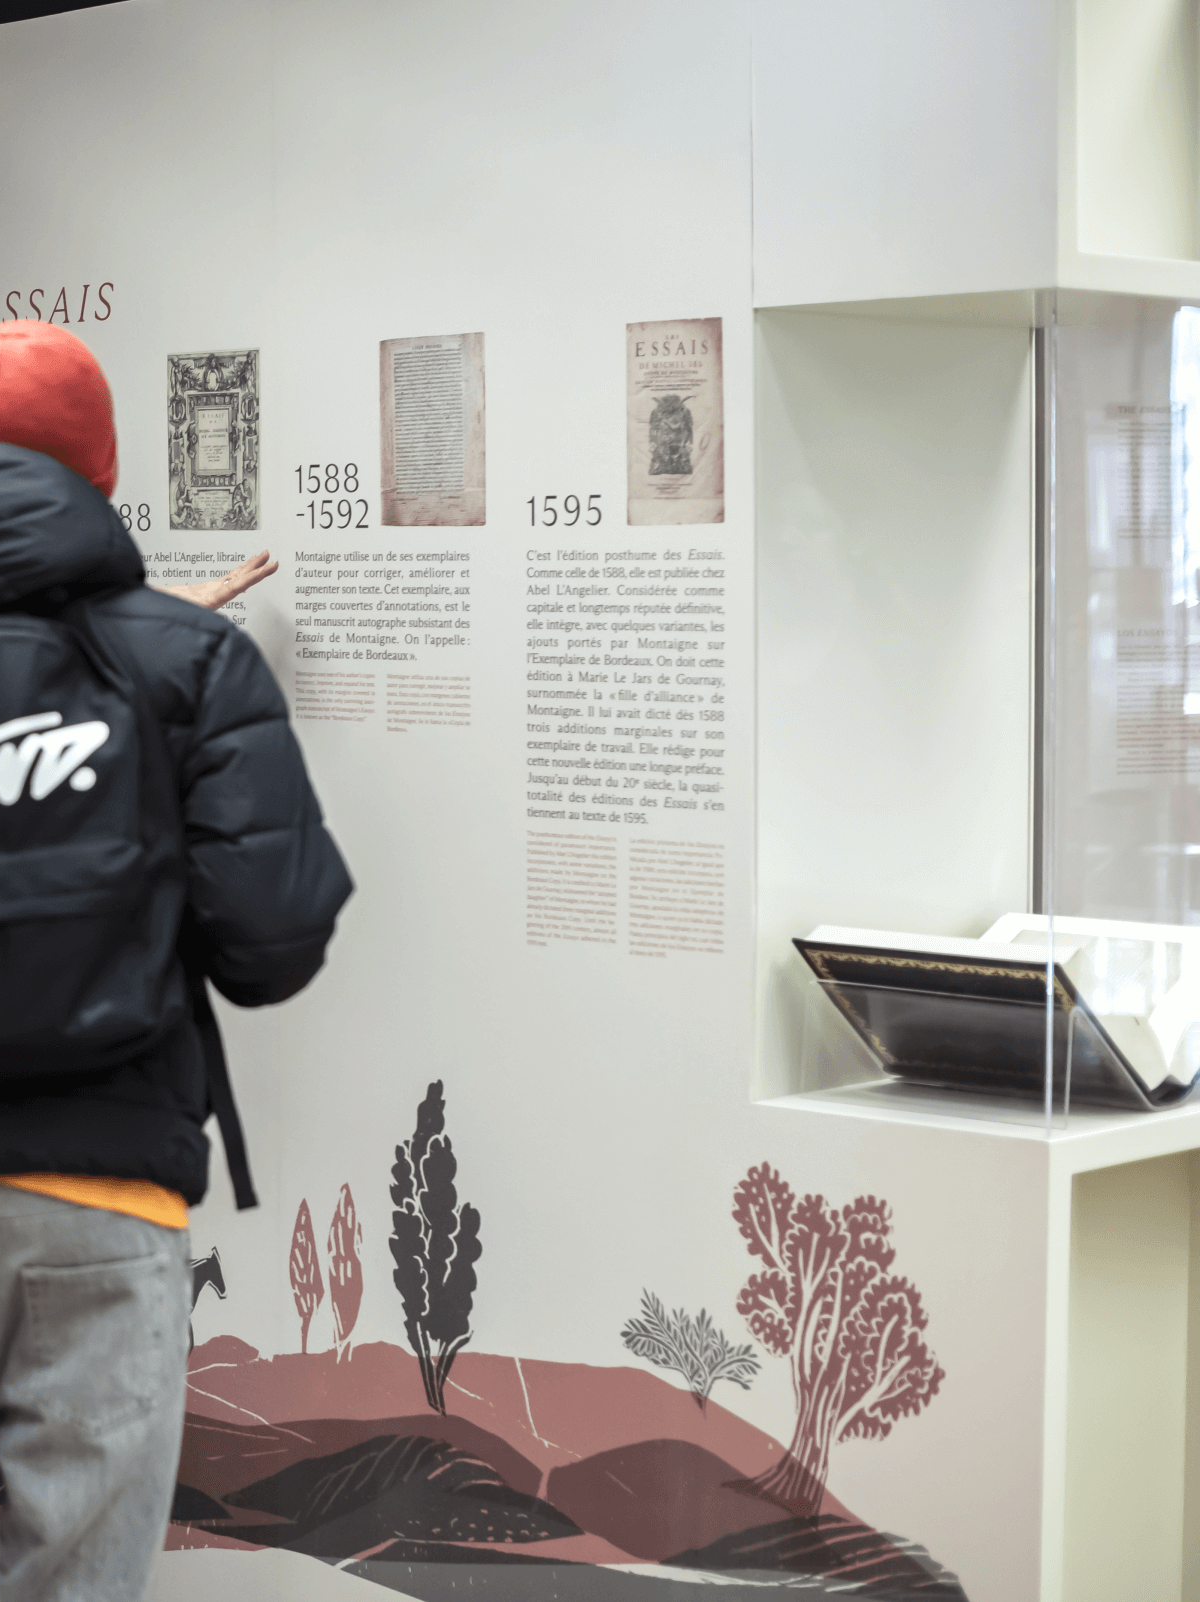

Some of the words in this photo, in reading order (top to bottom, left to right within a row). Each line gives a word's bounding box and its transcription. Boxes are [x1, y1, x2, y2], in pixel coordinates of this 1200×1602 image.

[636, 340, 708, 357] ESSAIS
[295, 463, 359, 493] 1588
[296, 499, 369, 529] -1592
[527, 494, 602, 526] 1595
[154, 552, 172, 562] Abel
[174, 552, 215, 564] L'Angelier,
[217, 552, 245, 562] libraire
[296, 552, 341, 564] Montaigne
[344, 552, 369, 561] utilise
[372, 553, 383, 561] un
[386, 552, 397, 561] de
[400, 553, 413, 561] ses
[416, 551, 469, 564] exemplaires
[526, 550, 551, 561] C'est
[557, 551, 598, 560] l'édition
[605, 551, 657, 562] posthume
[664, 550, 681, 560] des
[688, 549, 725, 560] Essais.
[162, 569, 191, 578] obtient
[295, 568, 332, 578] d'auteur
[337, 570, 359, 580] pour
[364, 570, 404, 580] corriger,
[409, 568, 455, 578] améliorer
[460, 570, 469, 578] et
[526, 568, 562, 577] Comme
[565, 568, 586, 577] celle
[589, 568, 600, 577] de
[603, 568, 627, 579] 1588,
[629, 568, 645, 577] elle
[648, 569, 661, 577] est
[664, 568, 699, 581] publiée
[702, 568, 724, 578] chez
[295, 586, 339, 596] augmenter
[359, 586, 382, 594] texte.
[384, 585, 399, 594] Cet
[402, 585, 452, 597] exemplaire,
[455, 587, 470, 595] aux
[527, 585, 550, 595] Abel
[557, 585, 610, 598] L'Angelier.
[617, 585, 677, 595] Considérée
[685, 587, 724, 595] comme
[296, 602, 326, 611] marges
[330, 602, 373, 610] couvertes
[377, 601, 441, 613] d'annotations,
[445, 603, 458, 611] est
[462, 602, 470, 612] le
[527, 602, 563, 614] capitale
[567, 603, 575, 612] et
[579, 603, 630, 615] longtemps
[633, 603, 671, 615] réputée
[674, 603, 725, 614] définitive,
[233, 615, 246, 625] Sur
[296, 617, 311, 626] seul
[314, 618, 355, 627] manuscrit
[358, 618, 406, 630] autographe
[409, 618, 452, 628] subsistant
[455, 619, 470, 628] des
[527, 620, 543, 629] elle
[546, 620, 583, 632] intègre,
[586, 622, 608, 630] avec
[611, 621, 655, 633] quelques
[659, 622, 707, 633] variantes,
[710, 622, 724, 632] les
[296, 632, 324, 642] Essais
[329, 633, 340, 642] de
[346, 633, 399, 646] Montaigne.
[405, 634, 419, 644] On
[527, 637, 558, 650] ajouts
[568, 638, 601, 650] portés
[611, 640, 628, 651] par
[638, 638, 698, 651] Montaigne
[708, 641, 725, 650] sur
[353, 649, 363, 659] de
[527, 653, 585, 666] l'Exemplaire
[589, 654, 601, 664] de
[604, 655, 653, 666] Bordeaux.
[657, 656, 672, 666] On
[676, 656, 695, 667] doit
[699, 658, 724, 668] cette
[527, 671, 562, 681] édition
[568, 672, 573, 681] à
[579, 672, 608, 682] Marie
[614, 673, 626, 683] Le
[632, 673, 652, 684] Jars
[658, 674, 670, 684] de
[676, 674, 725, 688] Gournay,
[527, 689, 587, 700] surnommée
[594, 689, 602, 700] la
[711, 693, 724, 703] de
[527, 704, 583, 718] Montaigne.
[588, 706, 594, 717] Il
[599, 707, 611, 718] lui
[616, 708, 640, 718] avait
[646, 709, 671, 719] dicté
[676, 710, 693, 720] dès
[699, 710, 724, 721] 1588
[527, 722, 550, 732] trois
[558, 723, 606, 734] additions
[614, 726, 672, 739] marginales
[681, 729, 697, 738] sur
[705, 730, 724, 739] son
[527, 739, 580, 751] exemplaire
[585, 741, 597, 751] de
[602, 742, 635, 753] travail.
[639, 743, 658, 754] Elle
[663, 745, 695, 758] rédige
[700, 747, 725, 759] pour
[527, 757, 549, 766] cette
[552, 758, 591, 768] nouvelle
[594, 760, 627, 770] édition
[629, 762, 646, 771] une
[650, 762, 682, 774] longue
[685, 763, 724, 776] préface.
[527, 772, 568, 786] Jusqu'au
[573, 775, 601, 786] début
[605, 776, 618, 787] du
[644, 779, 674, 791] siècle,
[679, 781, 688, 791] la
[692, 783, 725, 794] quasi-
[527, 790, 562, 801] totalité
[569, 792, 586, 803] des
[592, 794, 633, 806] éditions
[640, 796, 657, 807] des
[664, 797, 697, 809] Essais
[704, 800, 724, 810] s'en
[527, 808, 565, 819] tiennent
[568, 810, 579, 820] au
[583, 811, 606, 821] texte
[609, 812, 620, 822] de
[624, 813, 648, 824] 1595.
